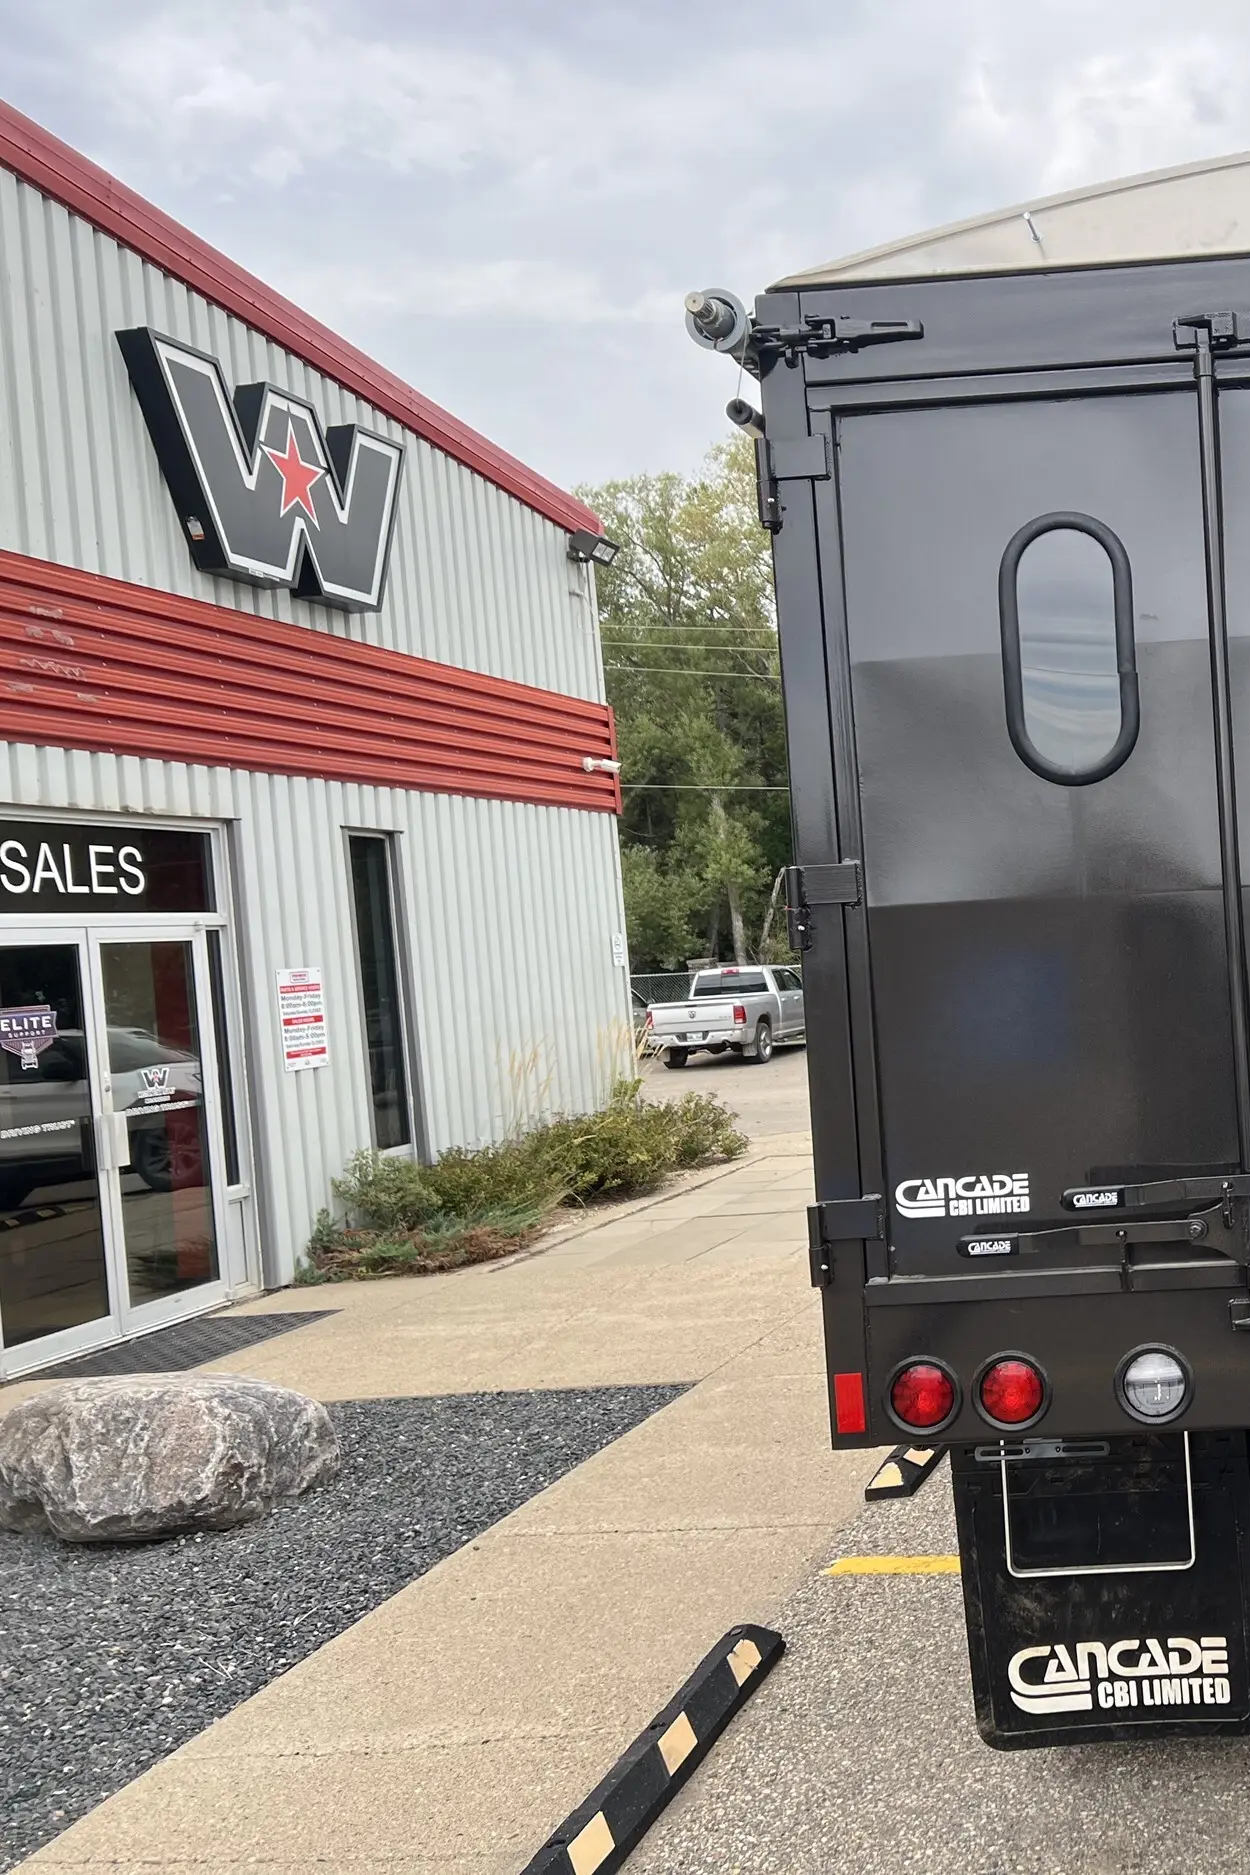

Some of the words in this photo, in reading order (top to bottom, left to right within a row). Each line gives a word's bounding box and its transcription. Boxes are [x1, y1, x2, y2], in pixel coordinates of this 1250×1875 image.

[0, 840, 146, 895] SALES
[0, 1015, 52, 1032] ELITE
[8, 1029, 46, 1039] SUPPORT
[895, 1173, 1030, 1207] CANCADE
[1073, 1191, 1118, 1207] CANCADE
[949, 1199, 974, 1217] CBI
[976, 1196, 1030, 1215] LIMITED
[968, 1240, 1011, 1255] CANCADE
[1008, 1637, 1229, 1695] CANCADE
[1097, 1680, 1138, 1709] CBI
[1142, 1677, 1230, 1706] LIMITED
